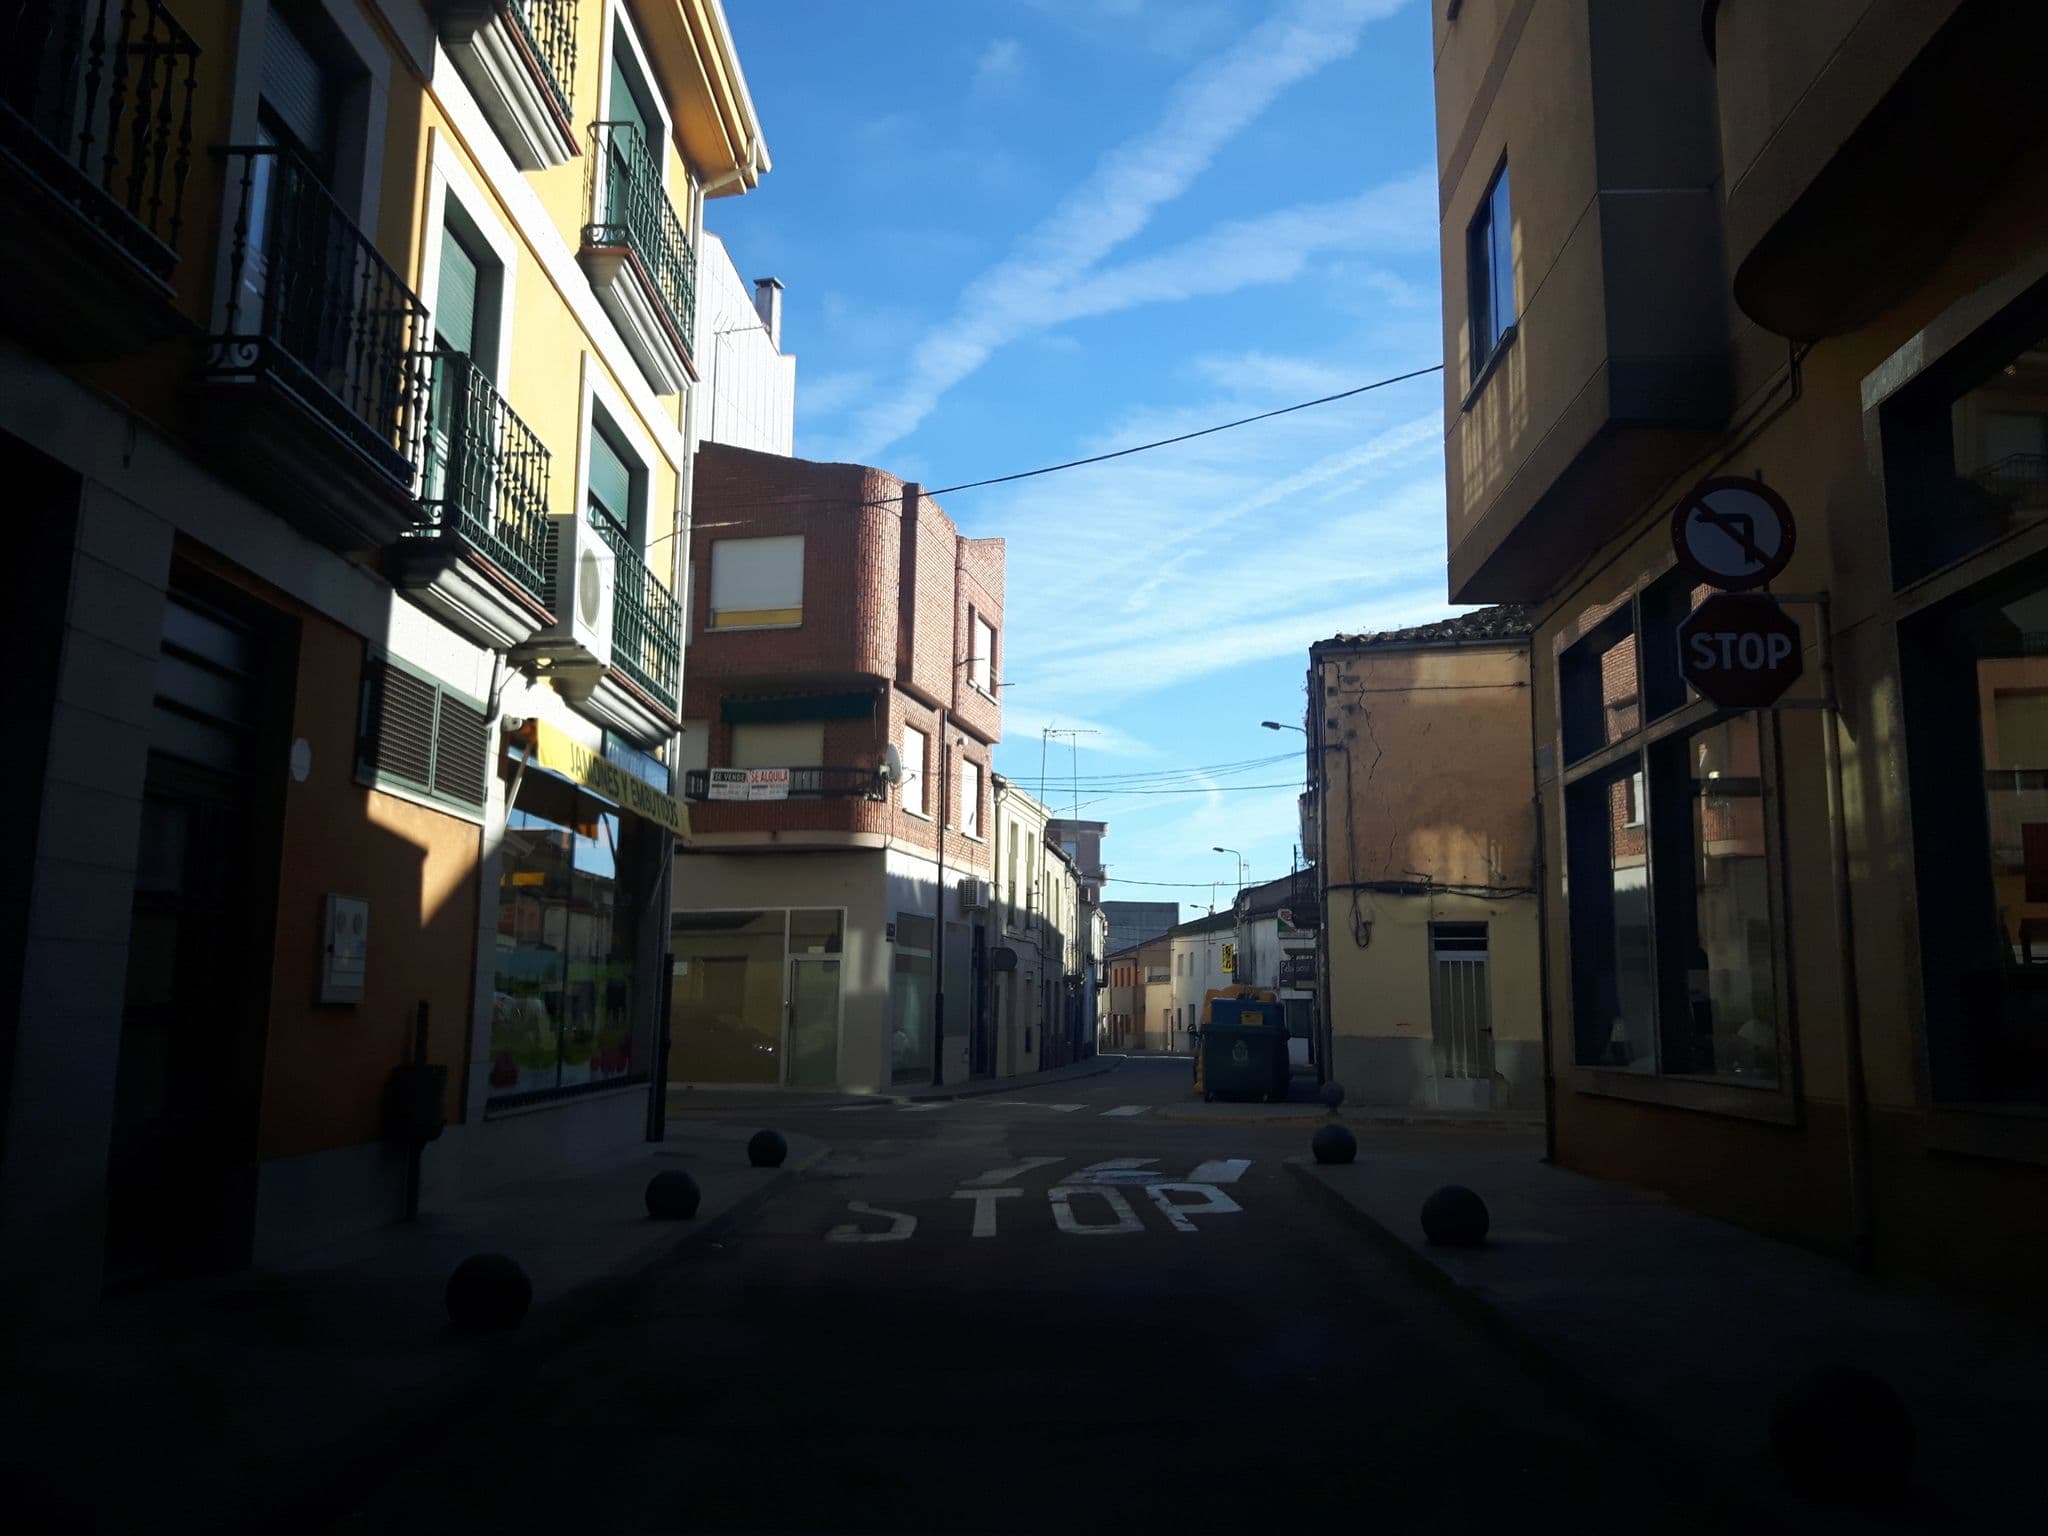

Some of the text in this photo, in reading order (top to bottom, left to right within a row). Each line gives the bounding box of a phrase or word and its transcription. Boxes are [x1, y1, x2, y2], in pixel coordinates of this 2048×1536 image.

[1690, 632, 1793, 672] STOP
[570, 743, 620, 798] JAMONES
[621, 773, 628, 802] Y
[630, 778, 679, 827] EMBUTIDOS
[750, 770, 788, 782] SE ALQUILA
[824, 1183, 1244, 1243] STOP
